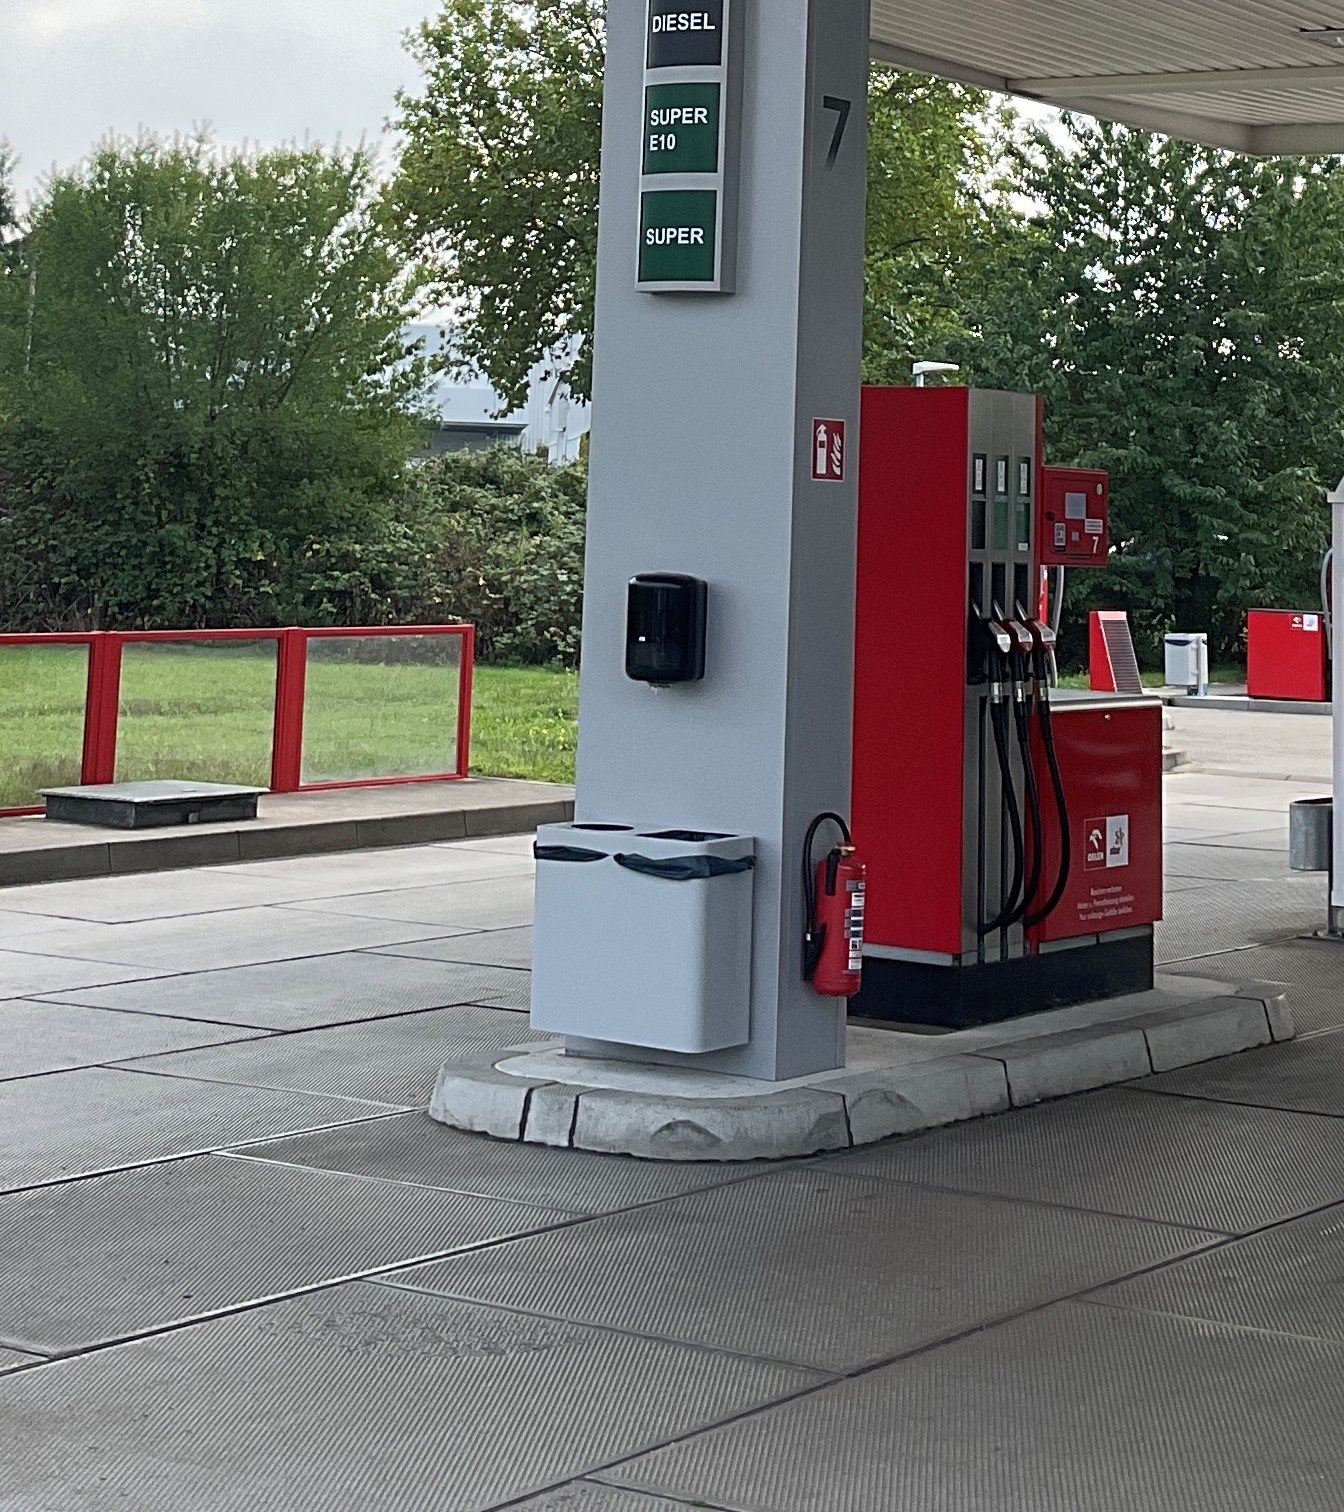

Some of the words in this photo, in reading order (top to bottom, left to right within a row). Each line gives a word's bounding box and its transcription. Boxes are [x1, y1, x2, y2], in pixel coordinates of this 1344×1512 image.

[652, 12, 716, 33] DIESEL
[650, 107, 708, 126] SUPER
[649, 133, 676, 151] E10
[822, 95, 851, 171] 7
[646, 227, 704, 245] SUPER
[1092, 536, 1099, 554] 7
